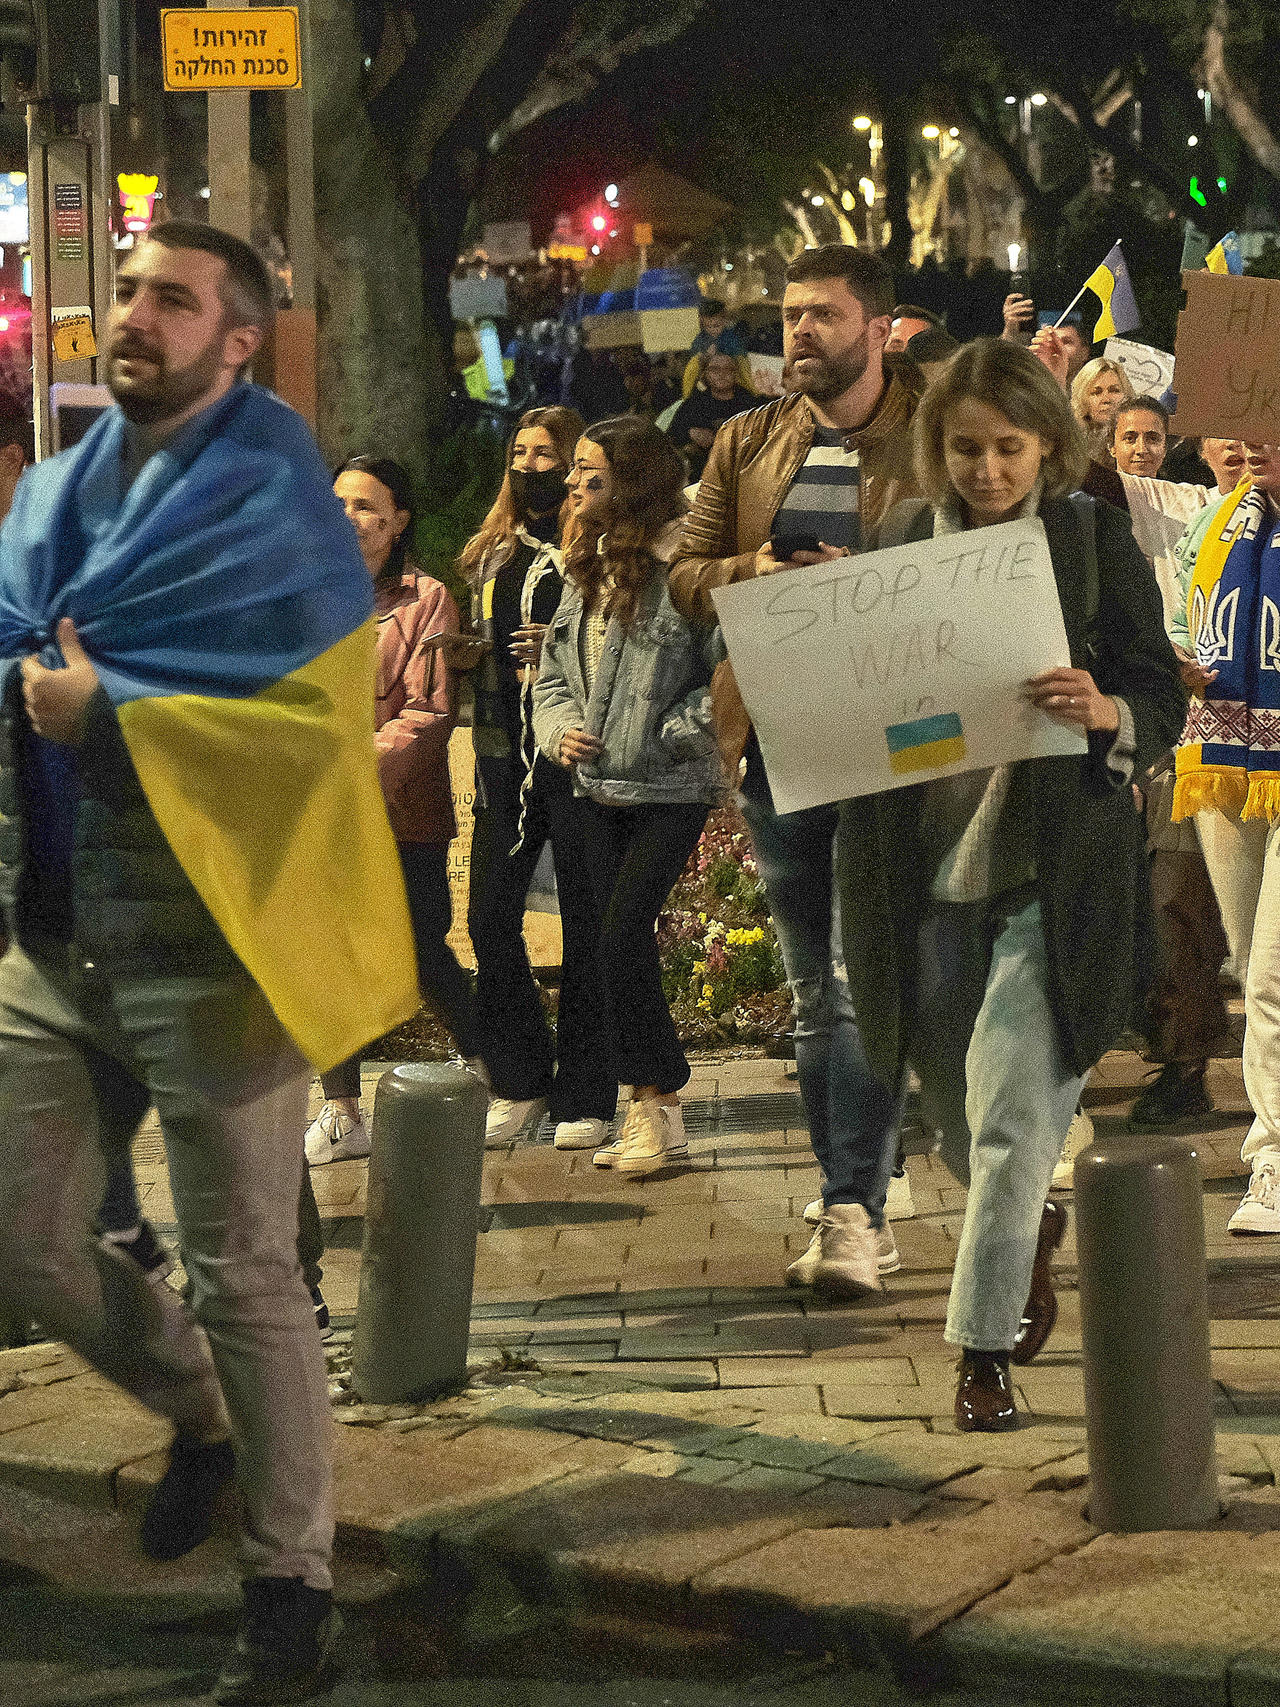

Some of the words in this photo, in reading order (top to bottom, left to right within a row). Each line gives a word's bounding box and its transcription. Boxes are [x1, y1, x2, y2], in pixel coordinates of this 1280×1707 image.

[193, 28, 268, 47] זהירות!
[174, 55, 236, 80] החלקה
[243, 58, 289, 75] סכנת
[766, 564, 922, 645] STOP
[938, 541, 1037, 592] THE
[849, 619, 988, 689] WAR
